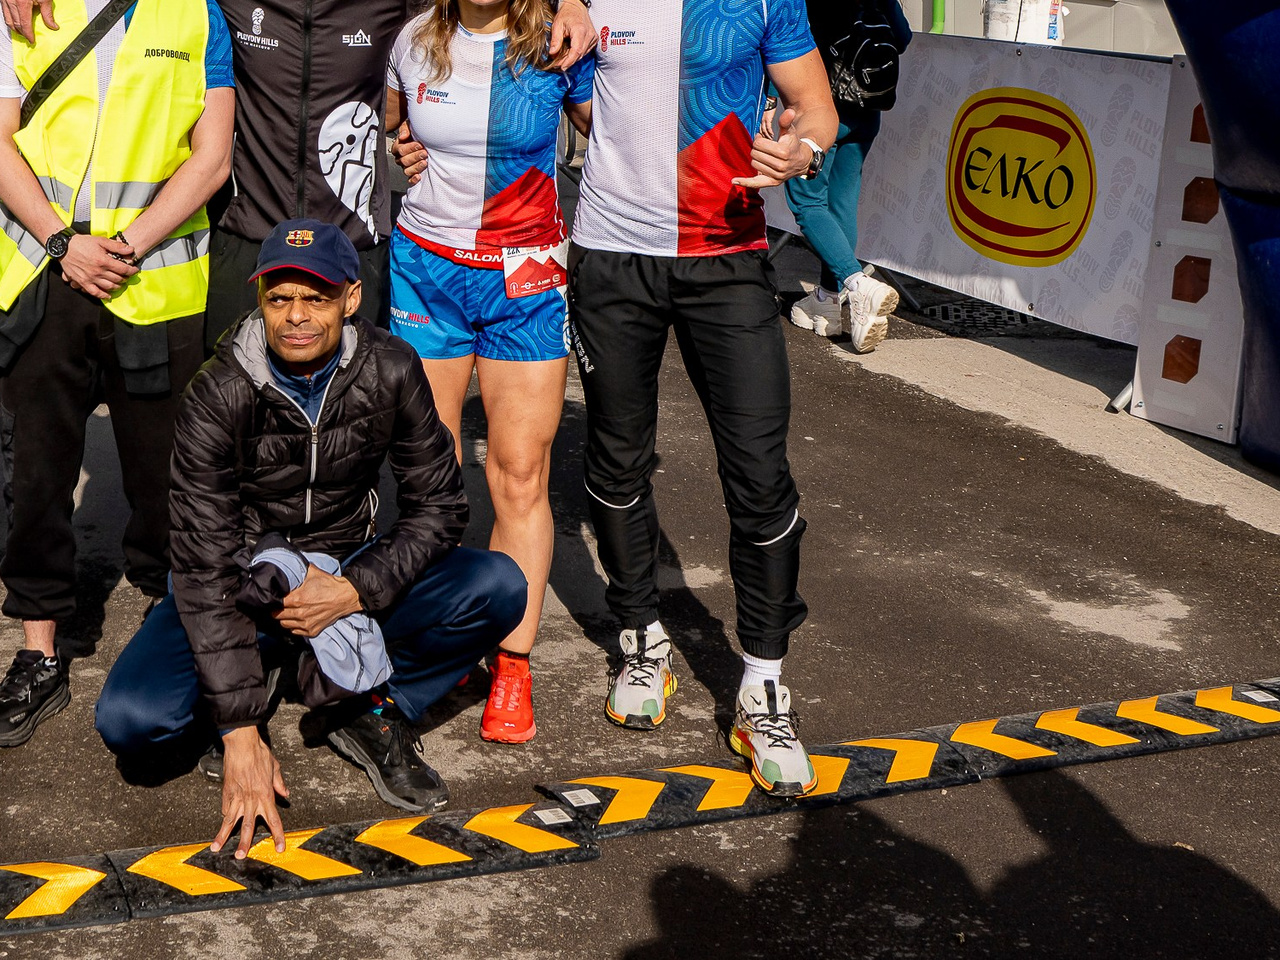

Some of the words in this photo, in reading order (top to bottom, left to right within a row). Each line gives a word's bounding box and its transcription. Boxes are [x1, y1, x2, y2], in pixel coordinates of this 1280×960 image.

[261, 37, 279, 47] HILLS
[610, 38, 626, 46] HILLS
[144, 48, 191, 62] ДОБРОВОЛЕЦ
[964, 146, 1074, 210] ЕЛКО
[408, 312, 430, 324] HILLS
